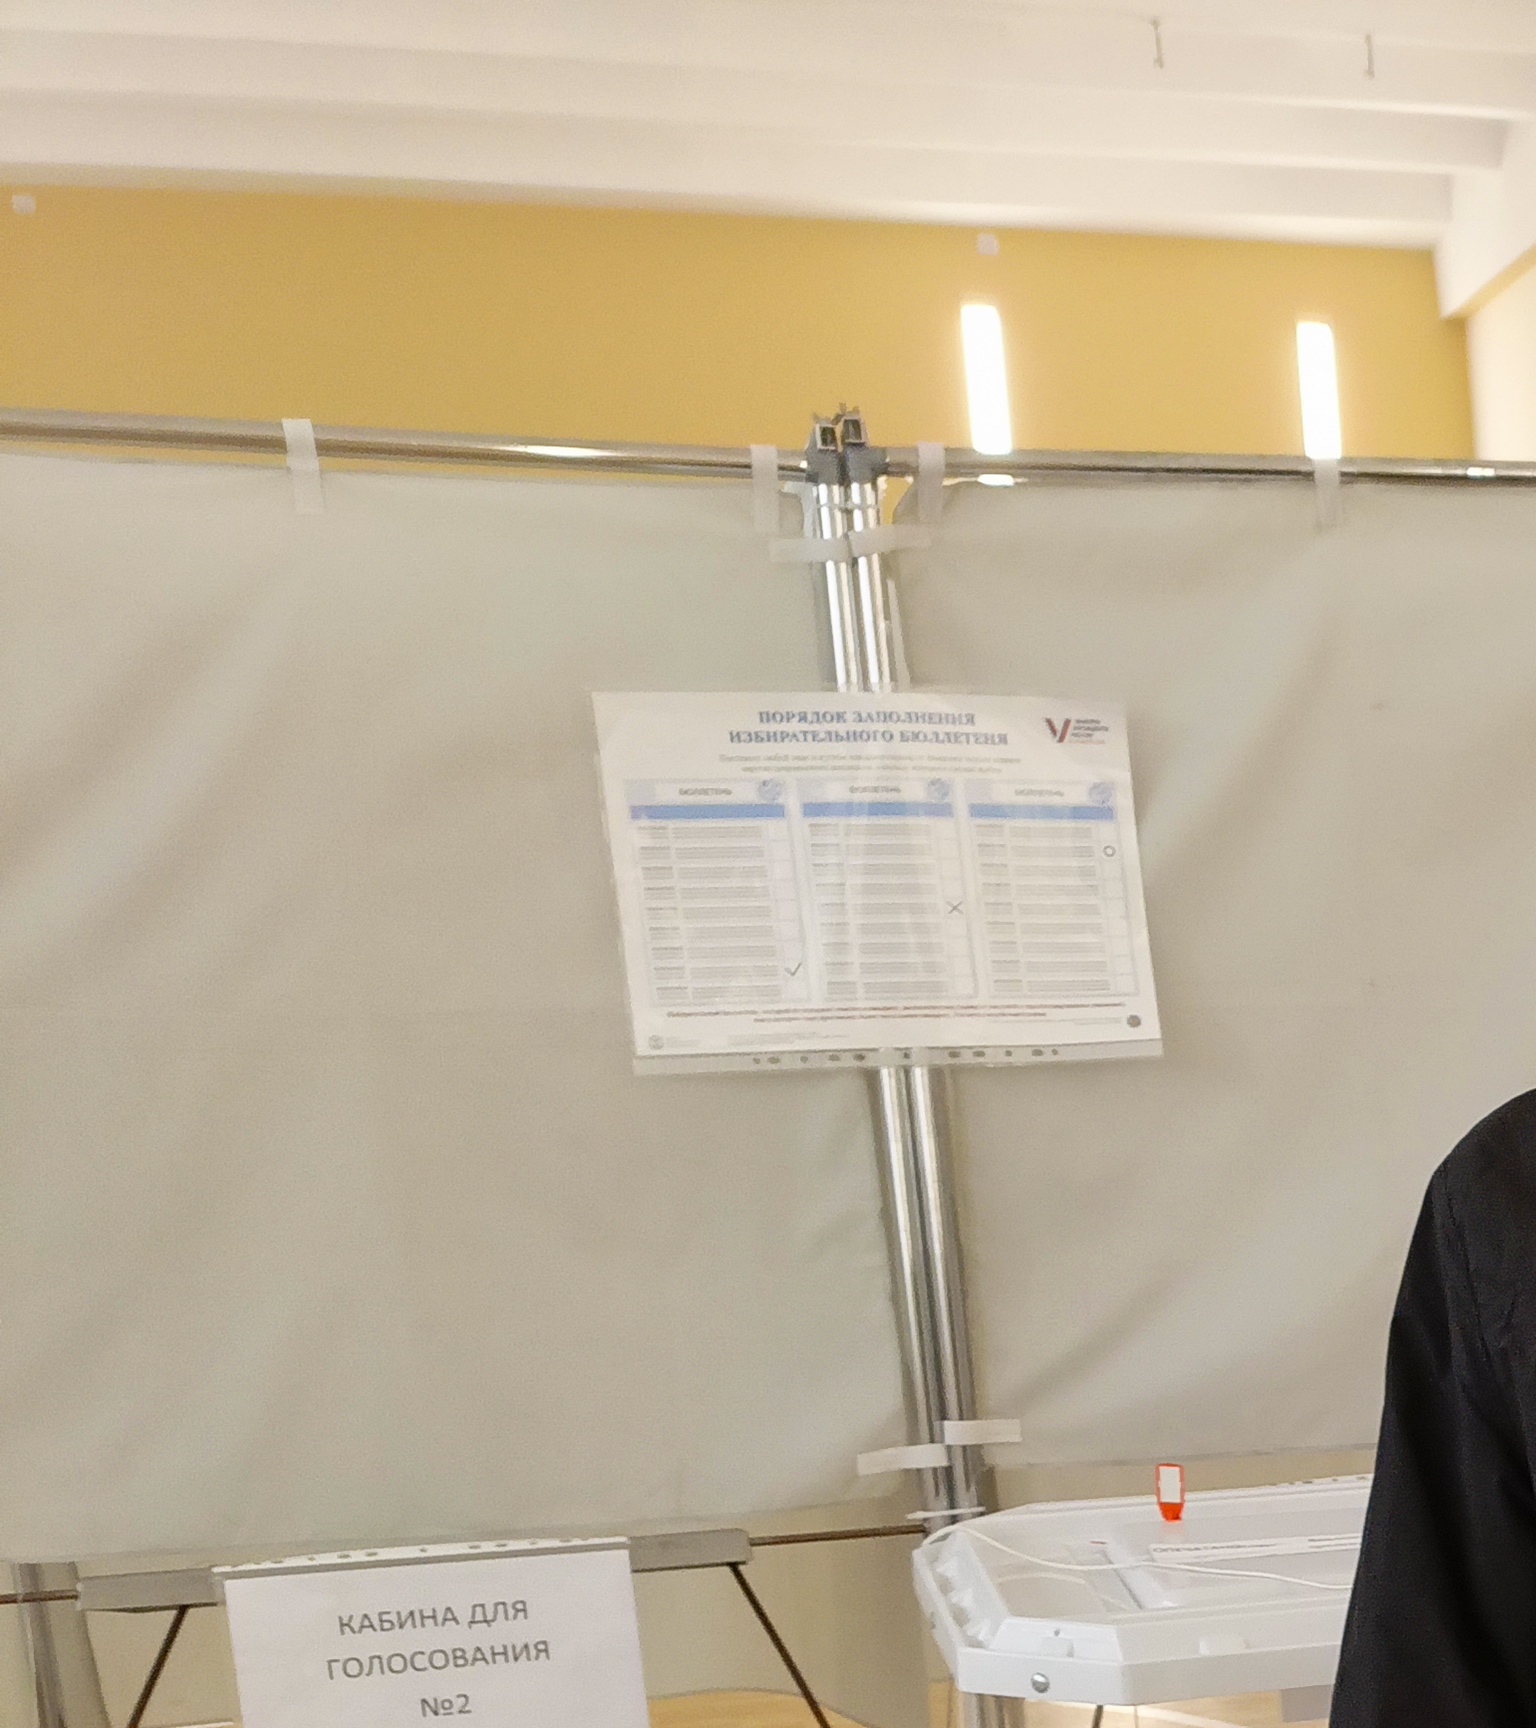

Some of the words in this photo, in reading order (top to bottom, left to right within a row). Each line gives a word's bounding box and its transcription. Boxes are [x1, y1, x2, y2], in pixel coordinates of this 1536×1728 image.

[758, 710, 848, 725] ПОРЯДОК
[852, 711, 976, 726] ЗАПОЛНЕНИЯ
[729, 729, 894, 745] ИЗБИРАТЕЛЬНОГО
[899, 730, 1009, 746] БЮЛЛЕТЕНЯ
[338, 1605, 460, 1635] КАБИНА
[467, 1599, 529, 1628] ДЛЯ
[326, 1639, 551, 1681] ГОЛОСОВАНИЯ
[420, 1693, 473, 1718] №2
